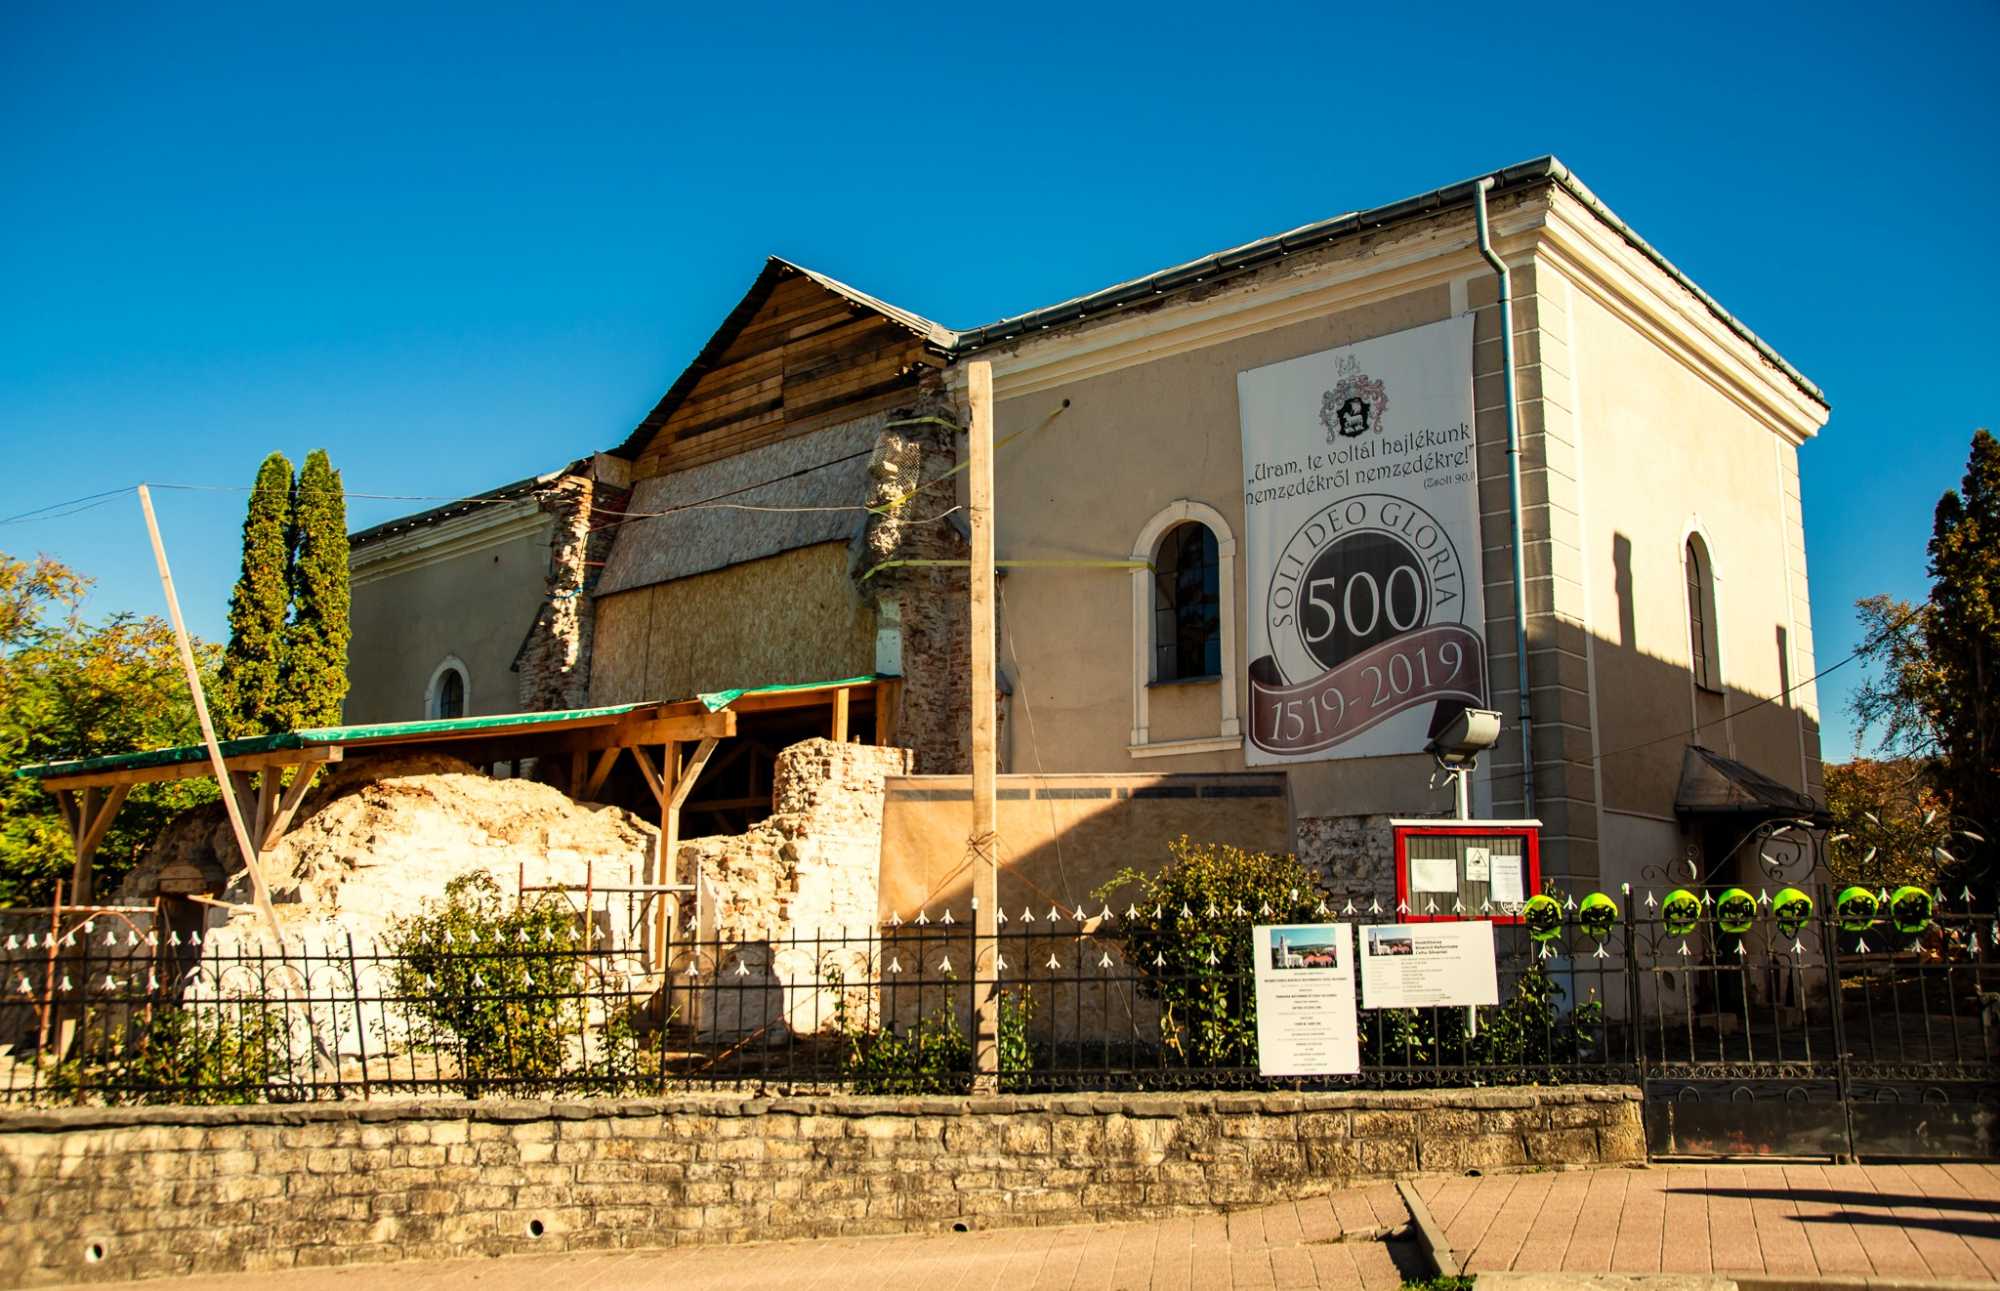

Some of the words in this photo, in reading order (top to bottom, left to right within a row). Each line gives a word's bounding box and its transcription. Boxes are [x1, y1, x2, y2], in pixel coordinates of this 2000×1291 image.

[1307, 455, 1323, 472] te
[1327, 440, 1375, 466] voltál
[1382, 422, 1470, 457] hajlékunk
[1245, 468, 1350, 506] nemzedékről
[1272, 553, 1305, 628] SOLI
[1304, 501, 1367, 549] DEO
[1380, 502, 1458, 608] GLORIA
[1305, 565, 1424, 643] 500
[1271, 641, 1464, 741] 1519-2019
